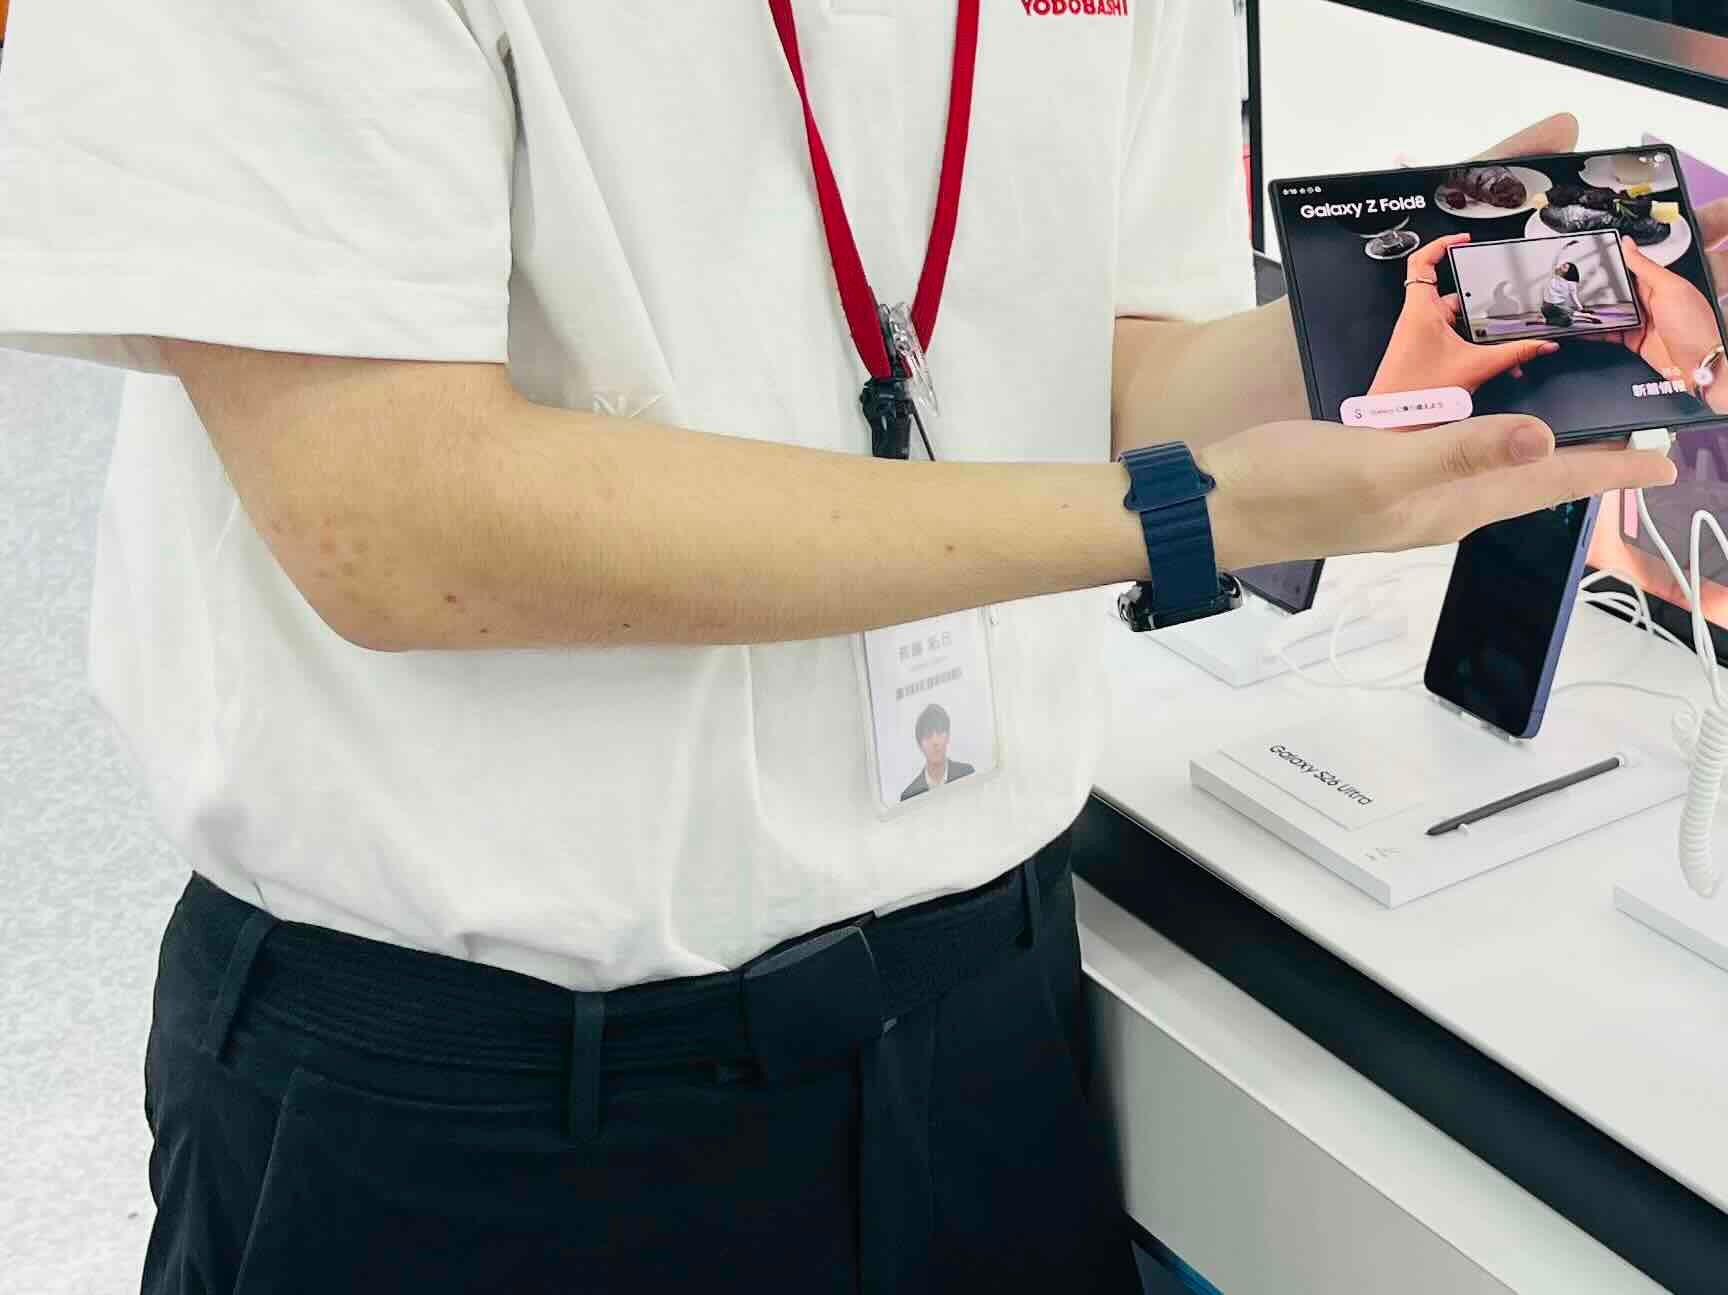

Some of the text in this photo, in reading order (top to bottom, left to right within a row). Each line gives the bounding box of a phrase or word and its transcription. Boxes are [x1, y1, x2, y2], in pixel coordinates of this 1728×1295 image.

[1300, 195, 1426, 219] Galaxy Z Fold8
[1269, 744, 1318, 773] Galaxy
